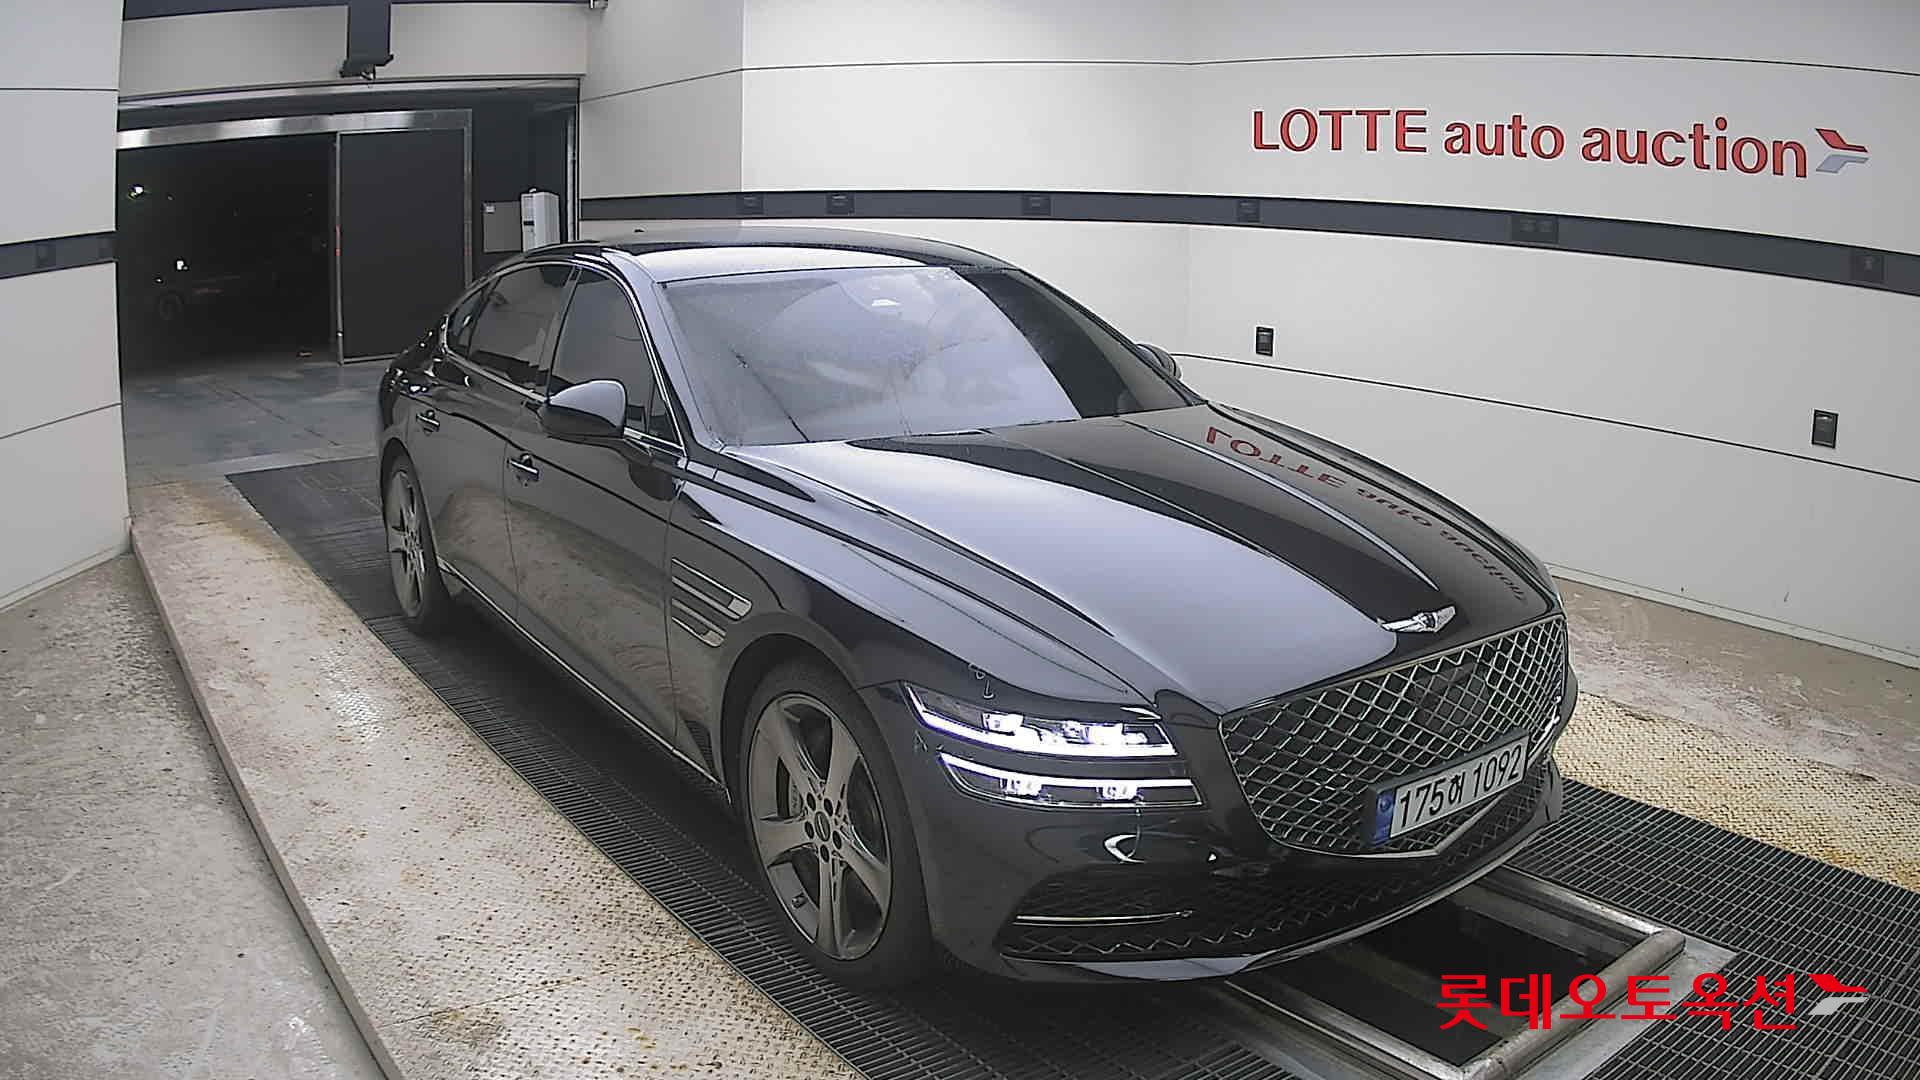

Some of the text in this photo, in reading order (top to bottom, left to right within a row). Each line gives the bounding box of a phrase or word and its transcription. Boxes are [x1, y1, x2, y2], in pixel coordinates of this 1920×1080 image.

[1253, 108, 1808, 178] LOTTE auto auction
[1400, 744, 1522, 828] 175허 1092
